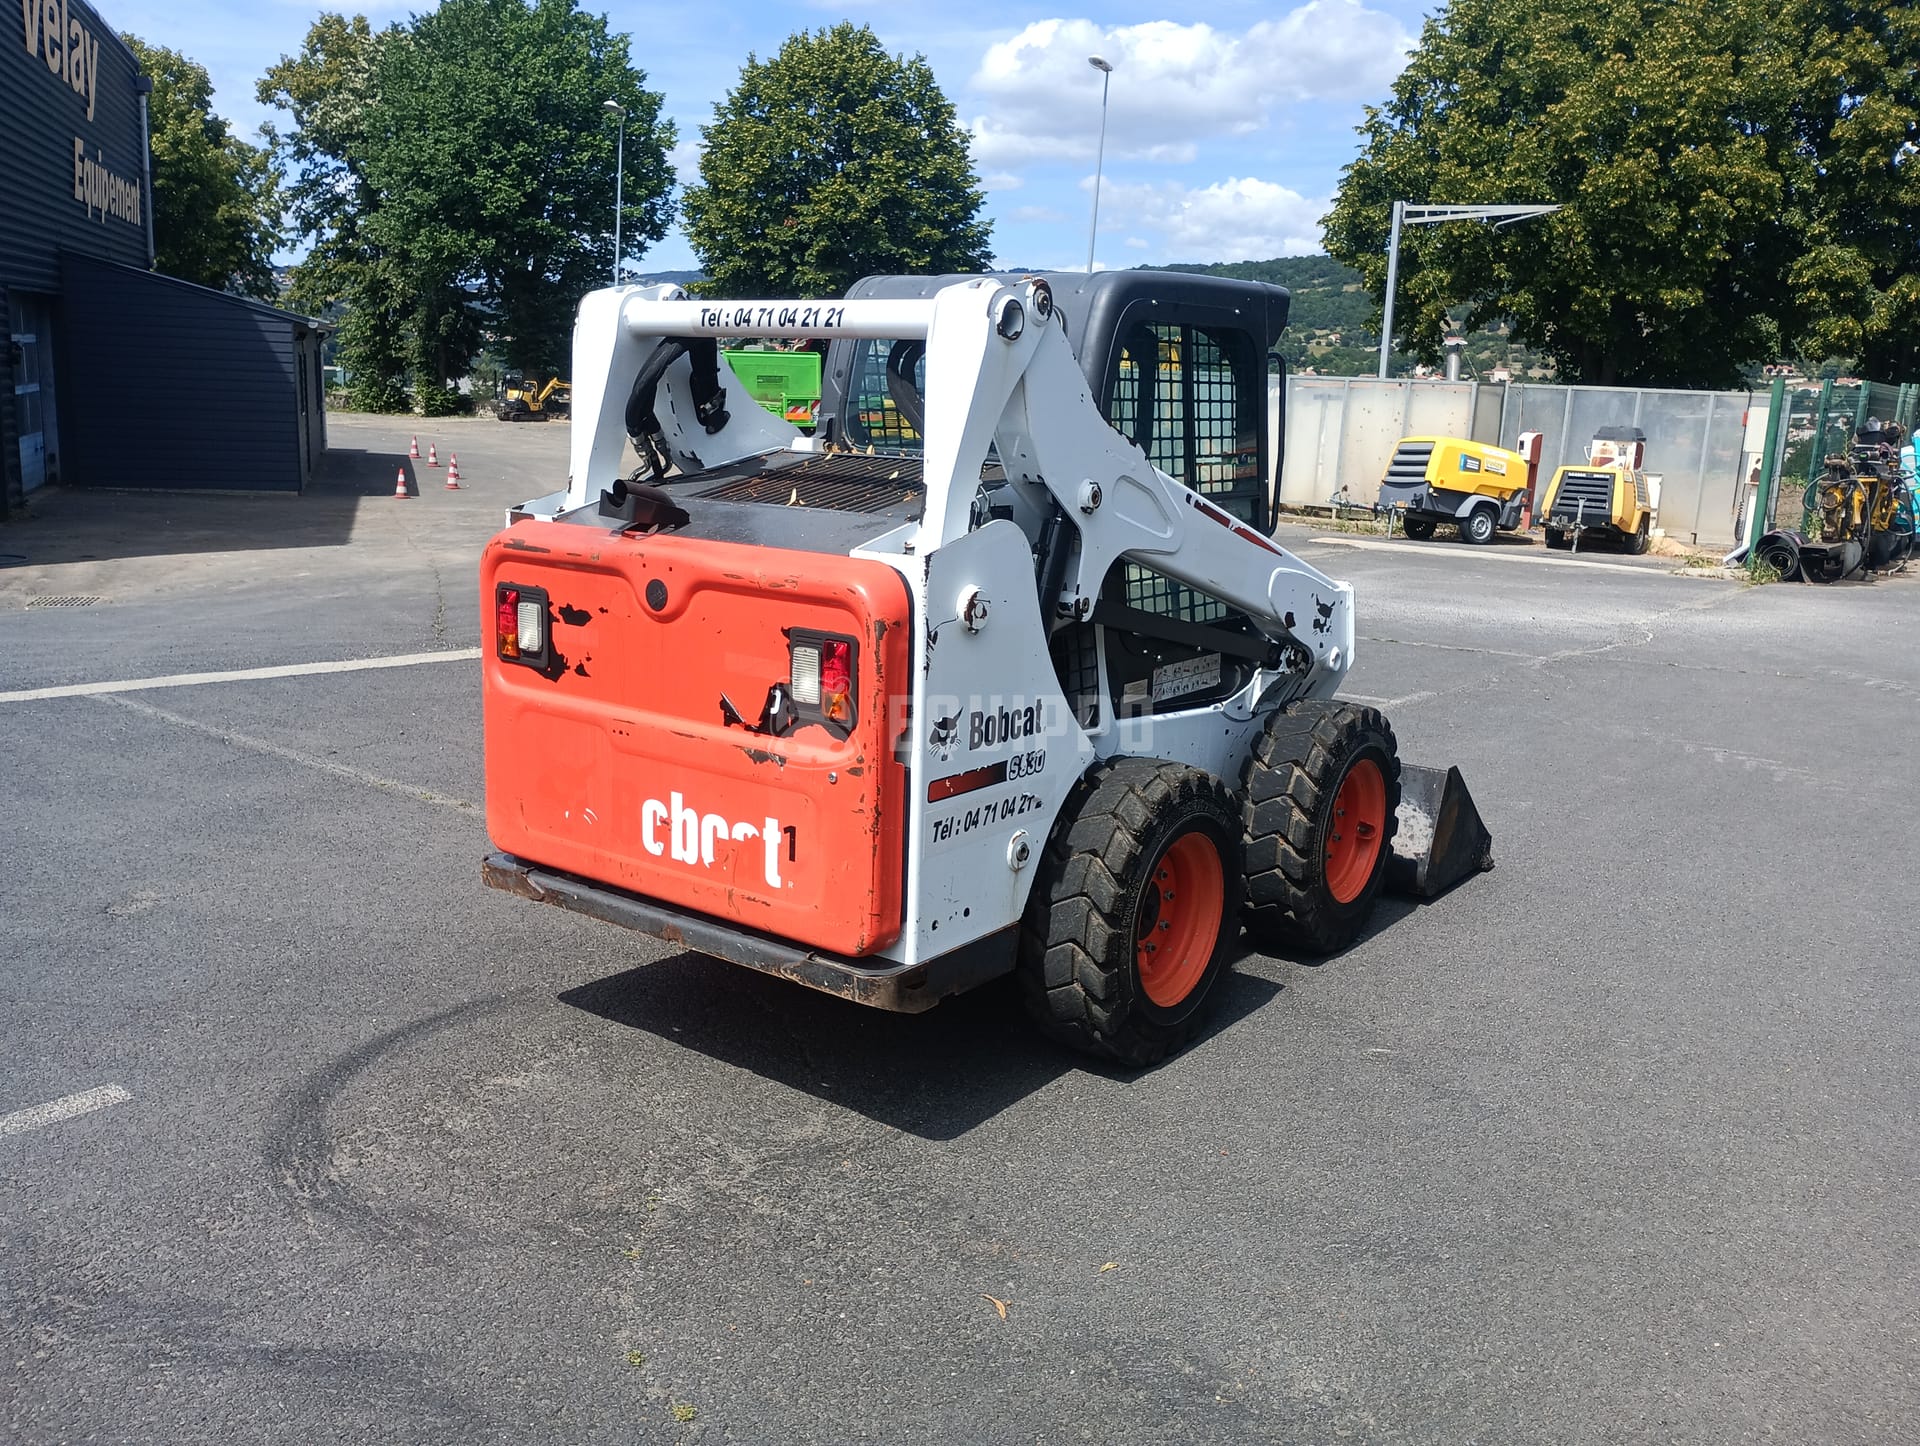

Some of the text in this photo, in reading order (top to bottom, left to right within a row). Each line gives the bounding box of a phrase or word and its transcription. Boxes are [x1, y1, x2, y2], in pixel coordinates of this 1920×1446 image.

[74, 136, 141, 226] Equipement
[734, 308, 753, 327] 04
[757, 308, 775, 327] 71
[778, 308, 798, 327] 04
[801, 308, 821, 327] 21
[824, 308, 845, 327] 21
[969, 699, 1042, 750] Bobcat
[933, 817, 954, 843] Tél
[964, 807, 980, 832] 04
[983, 802, 998, 826] 71
[1001, 796, 1017, 819] 04
